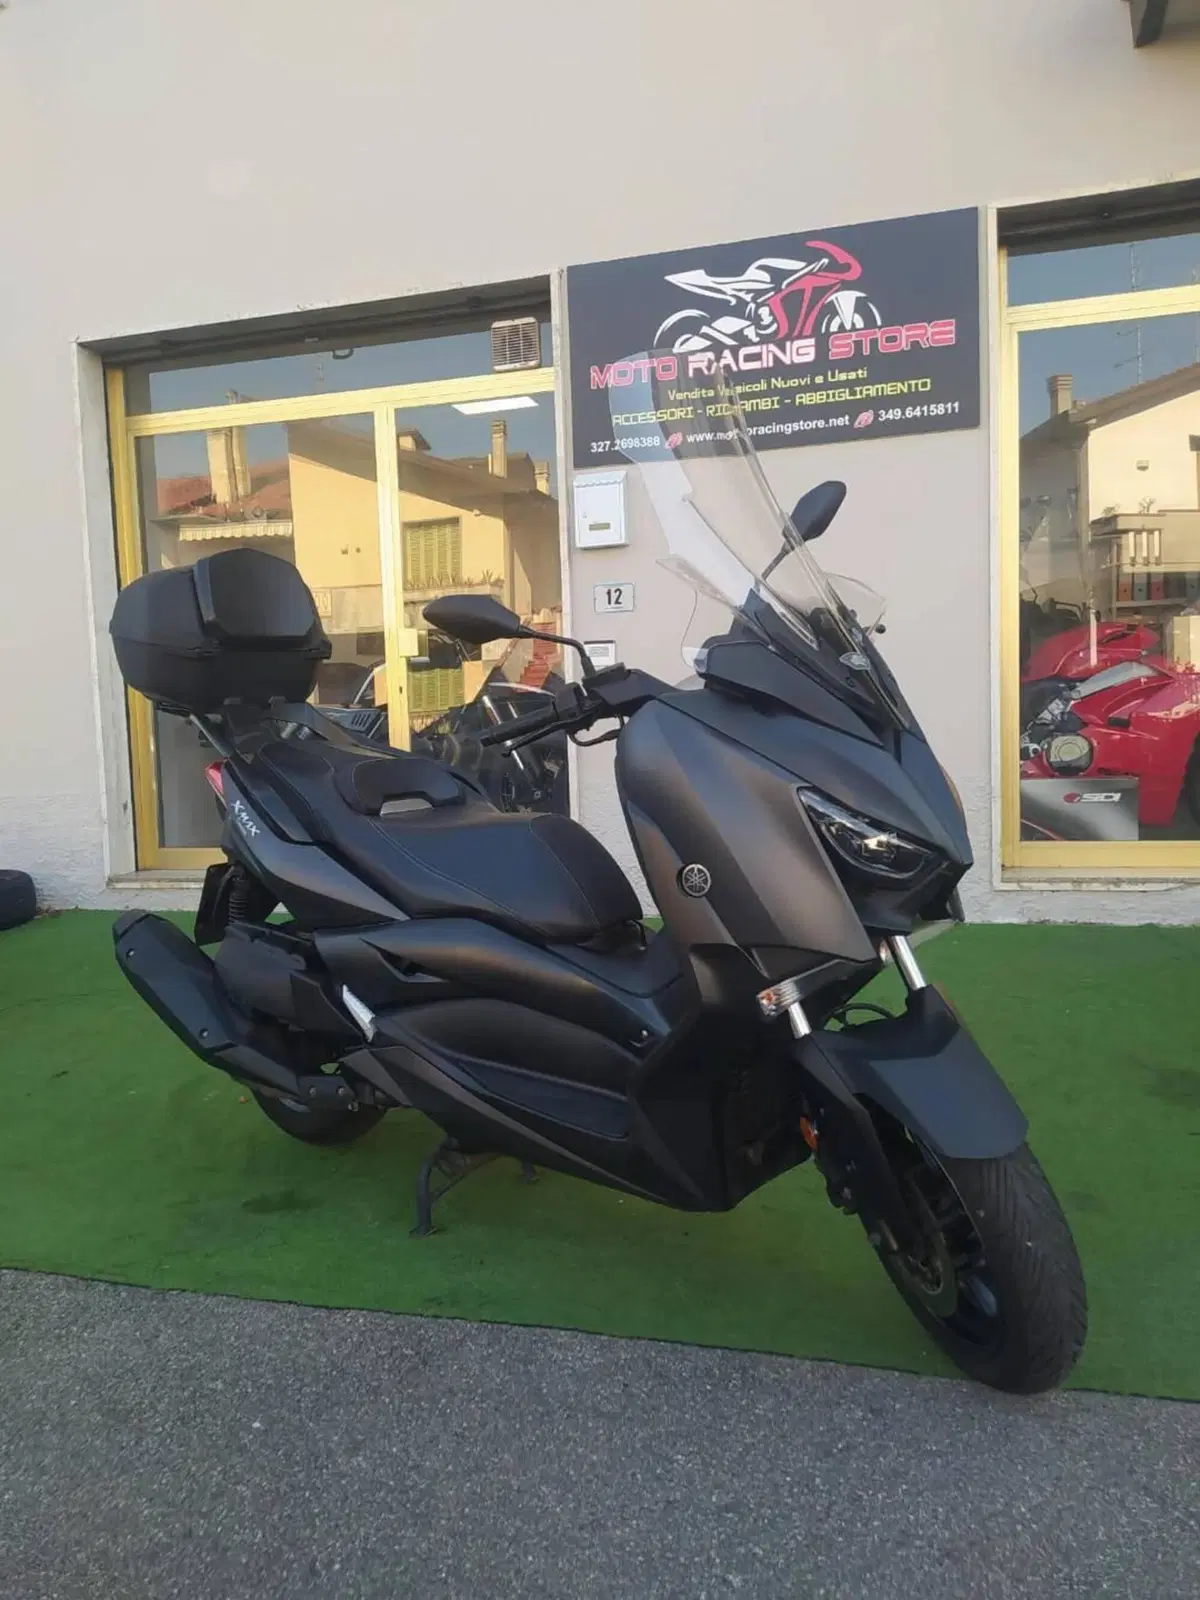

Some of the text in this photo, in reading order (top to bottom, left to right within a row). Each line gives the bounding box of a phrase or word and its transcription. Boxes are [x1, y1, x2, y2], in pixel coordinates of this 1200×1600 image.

[590, 319, 956, 390] MOTO RACING STORE
[612, 407, 695, 426] ACCESSORI
[795, 378, 931, 406] ABBIGLIAMENTO
[668, 387, 715, 401] Vendita
[771, 374, 811, 389] Nuovi
[814, 375, 824, 384] e
[828, 367, 868, 382] Usati
[590, 436, 661, 453] 327.2698388
[878, 401, 960, 421] 349.6415811
[606, 588, 623, 605] 12
[231, 800, 260, 836] XMAX
